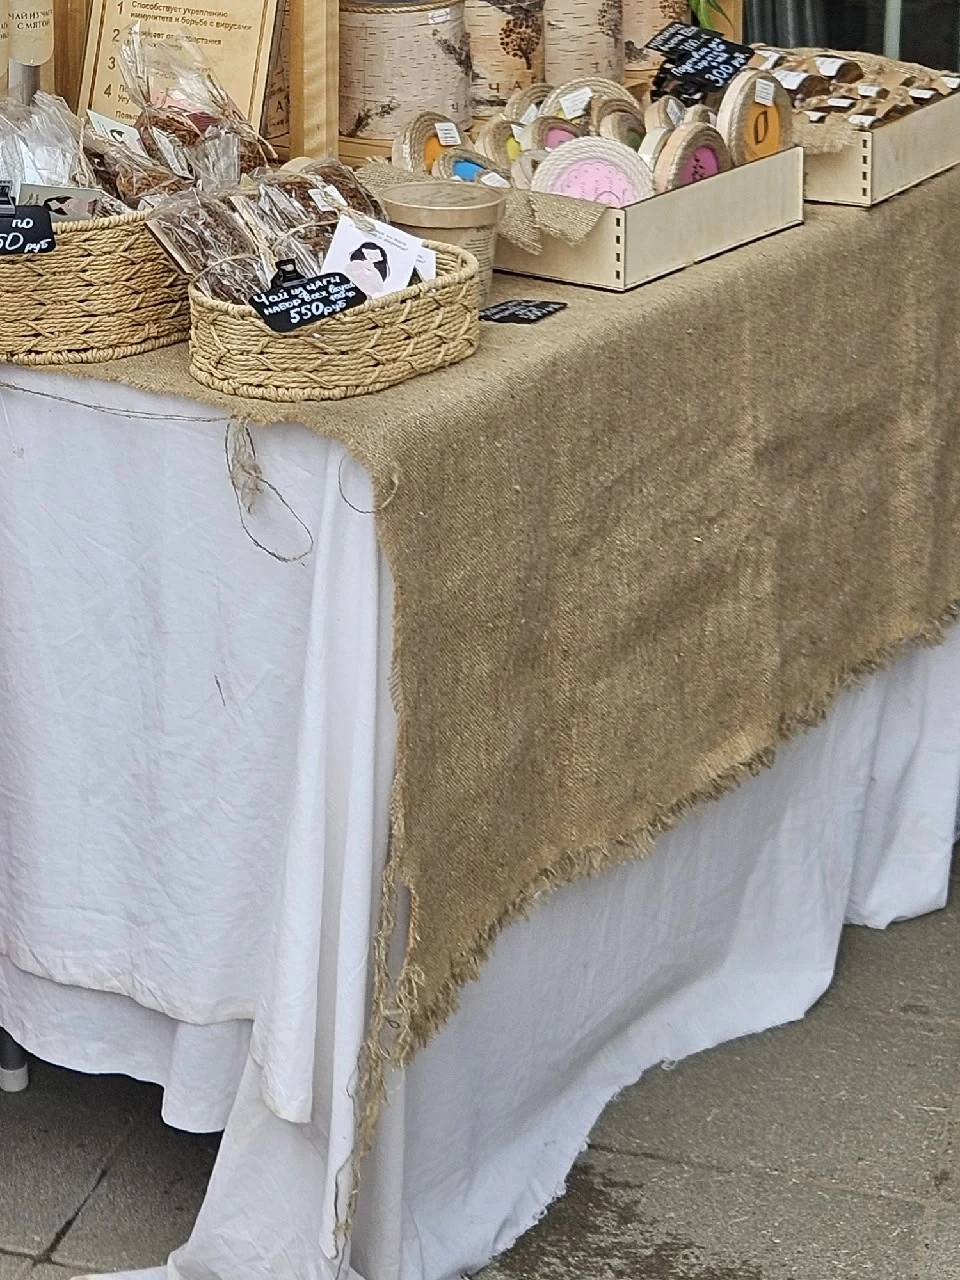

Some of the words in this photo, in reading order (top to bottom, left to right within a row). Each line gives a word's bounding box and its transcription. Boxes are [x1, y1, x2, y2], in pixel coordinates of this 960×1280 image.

[117, 1, 125, 15] 1
[112, 28, 120, 43] 2
[107, 56, 116, 70] 3
[705, 64, 733, 87] 300
[103, 83, 112, 98] 4
[11, 218, 34, 229] по
[253, 289, 289, 305] Чай
